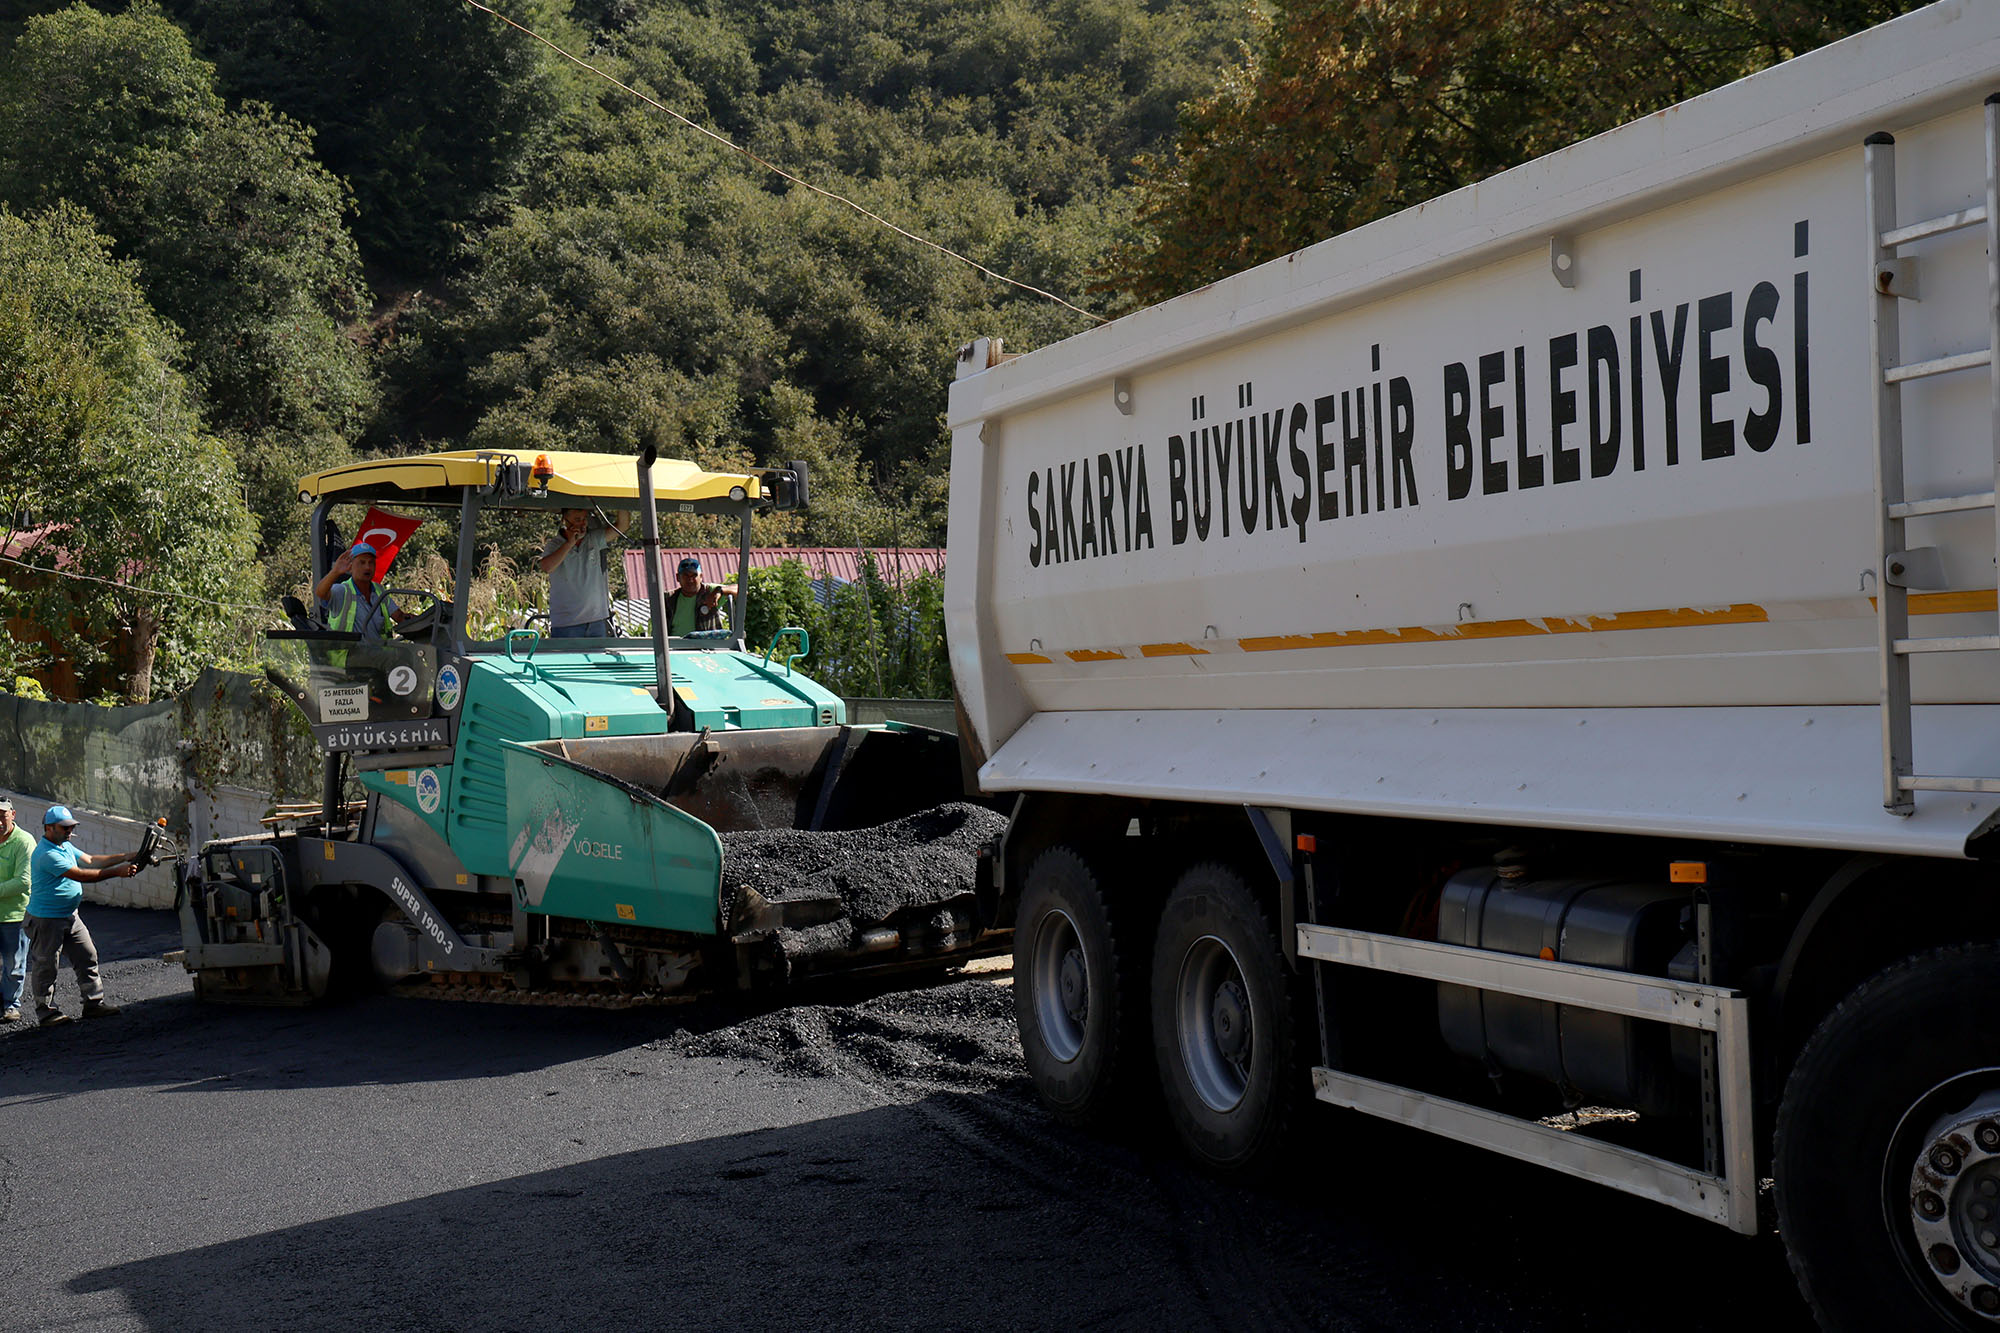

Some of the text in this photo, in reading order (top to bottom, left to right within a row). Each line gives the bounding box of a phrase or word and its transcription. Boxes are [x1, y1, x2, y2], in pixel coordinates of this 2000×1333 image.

[1027, 219, 1811, 568] SAKARYA BÜYÜKŞEHİR BELEDİYESİ
[332, 688, 364, 696] METREDEN
[395, 669, 410, 692] 2
[329, 707, 361, 717] YAKLAŞMA
[335, 698, 354, 706] FAZLA
[573, 837, 623, 860] VÖGELE
[391, 876, 454, 955] SUPER 1900-3
